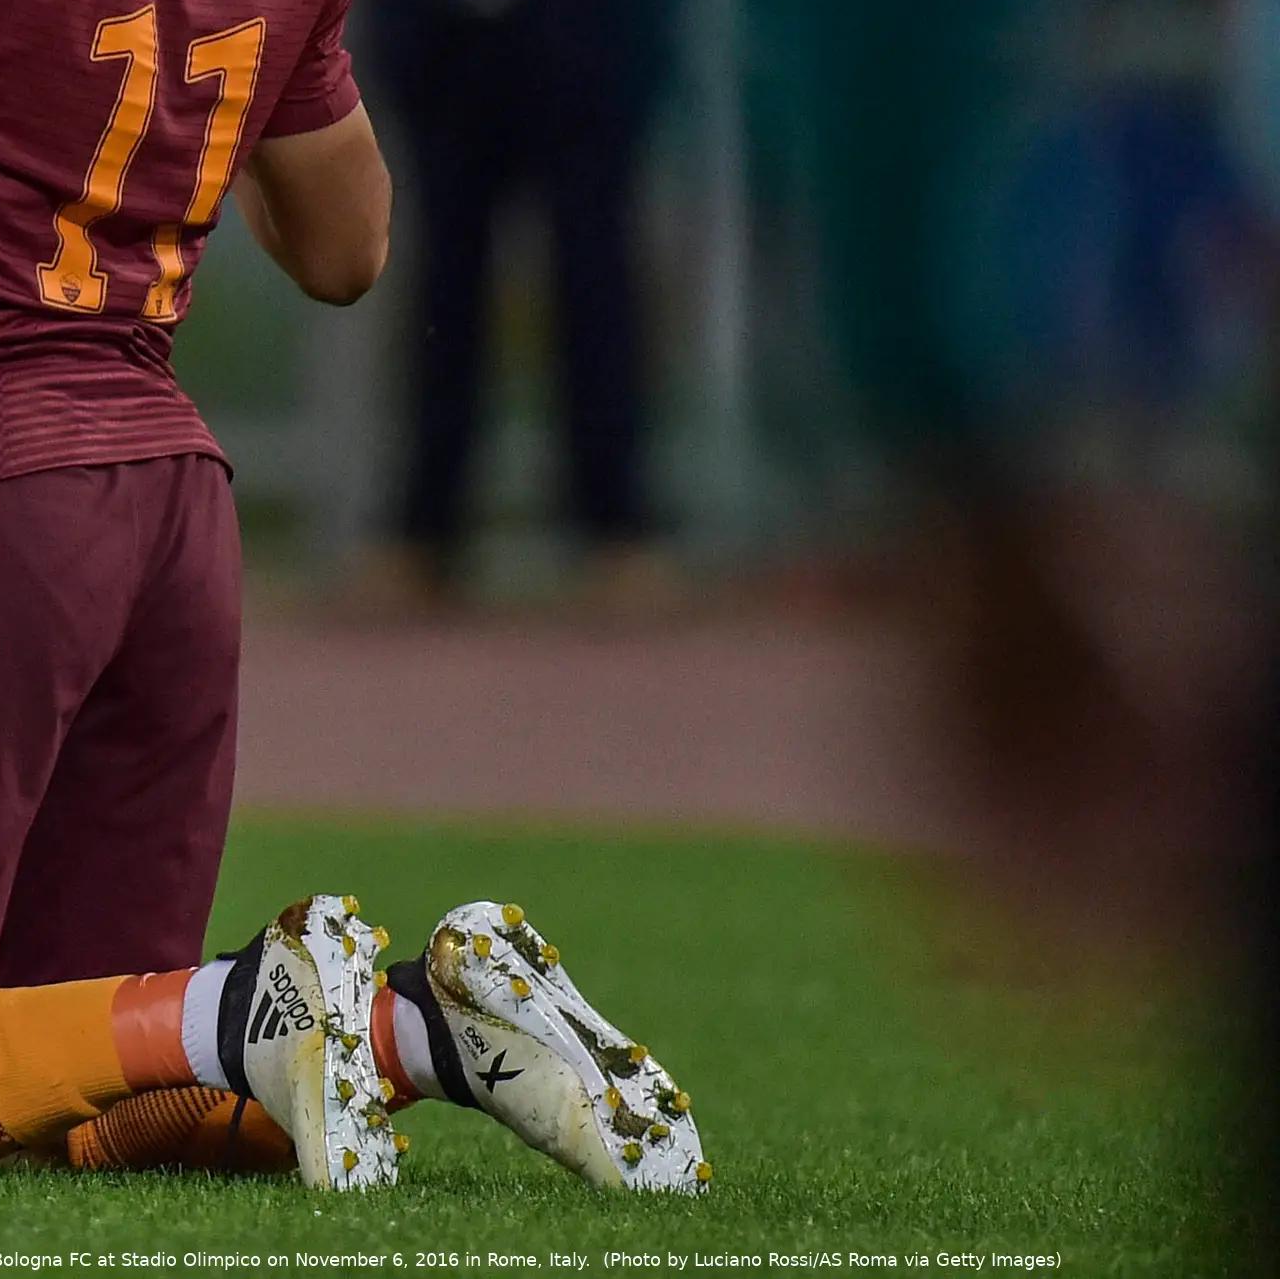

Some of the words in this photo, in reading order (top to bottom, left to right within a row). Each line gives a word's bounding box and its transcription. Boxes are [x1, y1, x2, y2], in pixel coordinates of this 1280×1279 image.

[36, 3, 266, 324] 11
[269, 963, 315, 1031] adidas
[465, 1026, 490, 1055] NSG
